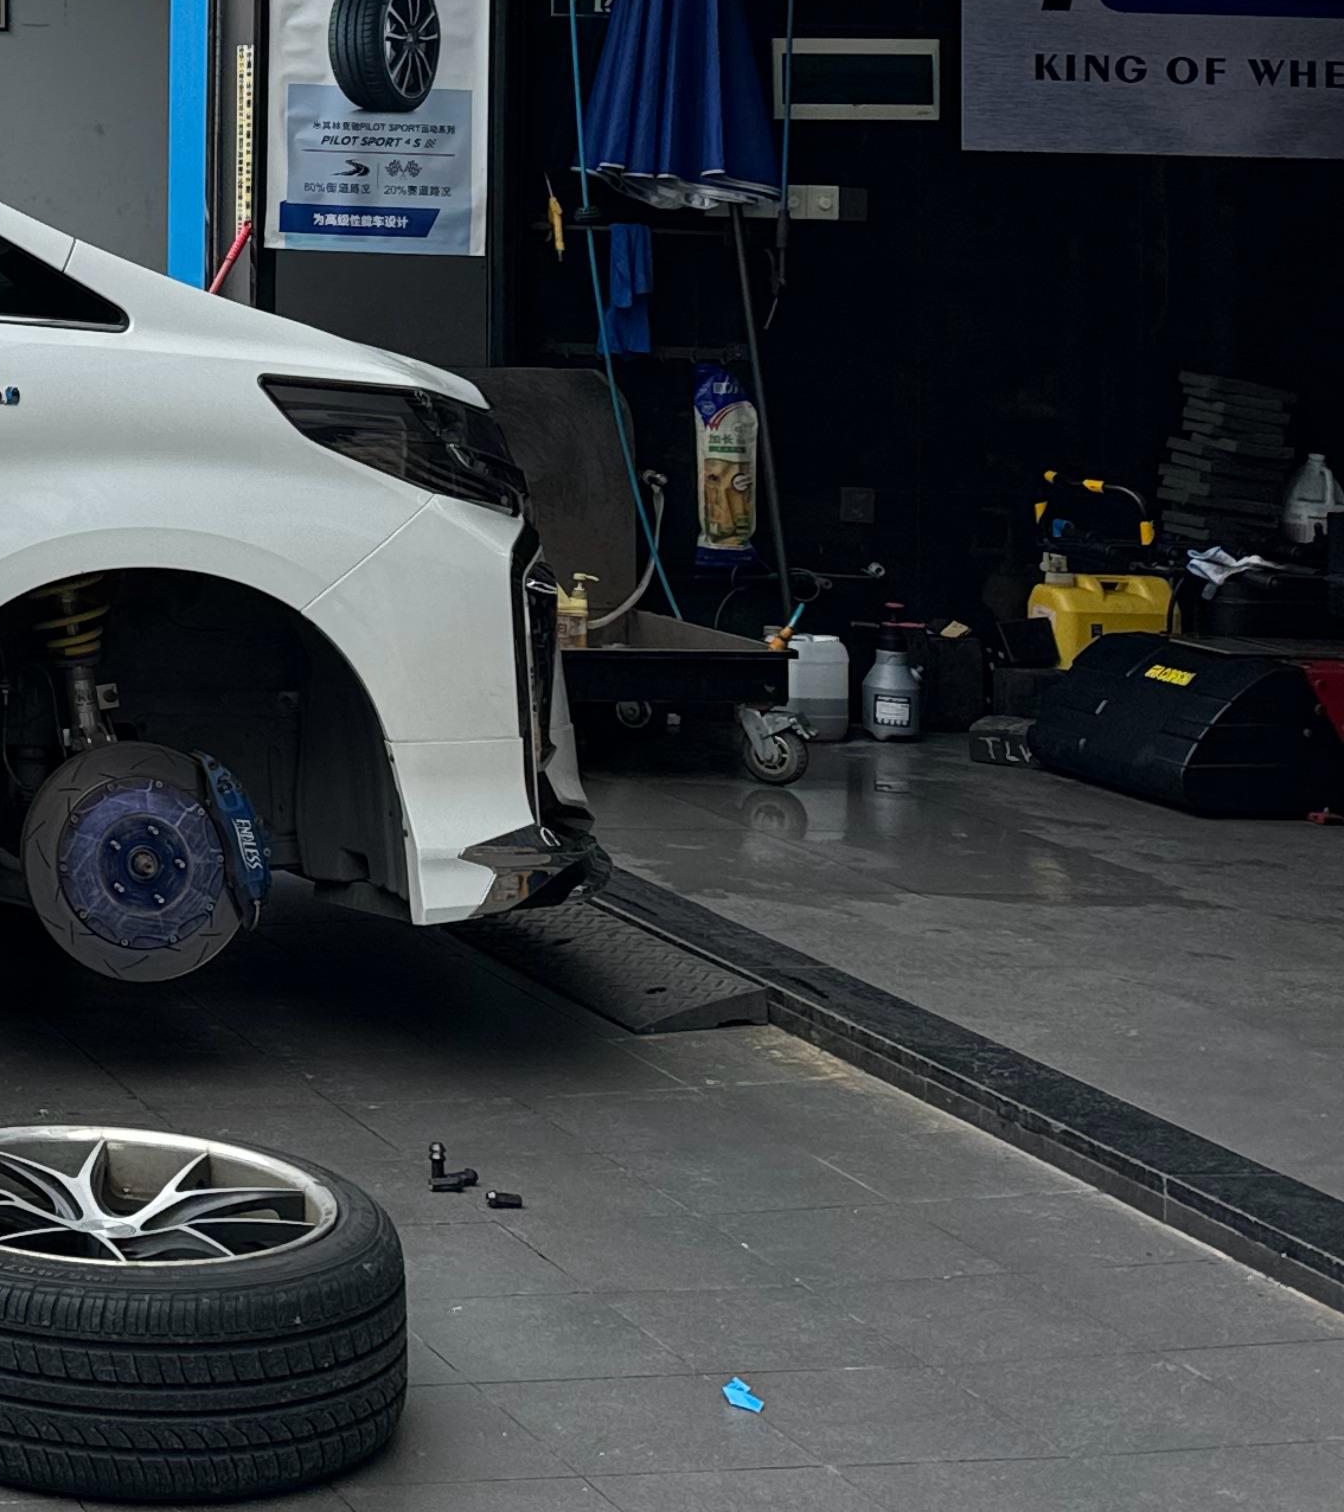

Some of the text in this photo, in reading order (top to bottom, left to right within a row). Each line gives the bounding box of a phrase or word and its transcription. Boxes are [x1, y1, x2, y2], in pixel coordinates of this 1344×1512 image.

[1036, 53, 1344, 89] KING OF WHE
[320, 135, 359, 146] PILOT
[360, 136, 402, 148] SPORT
